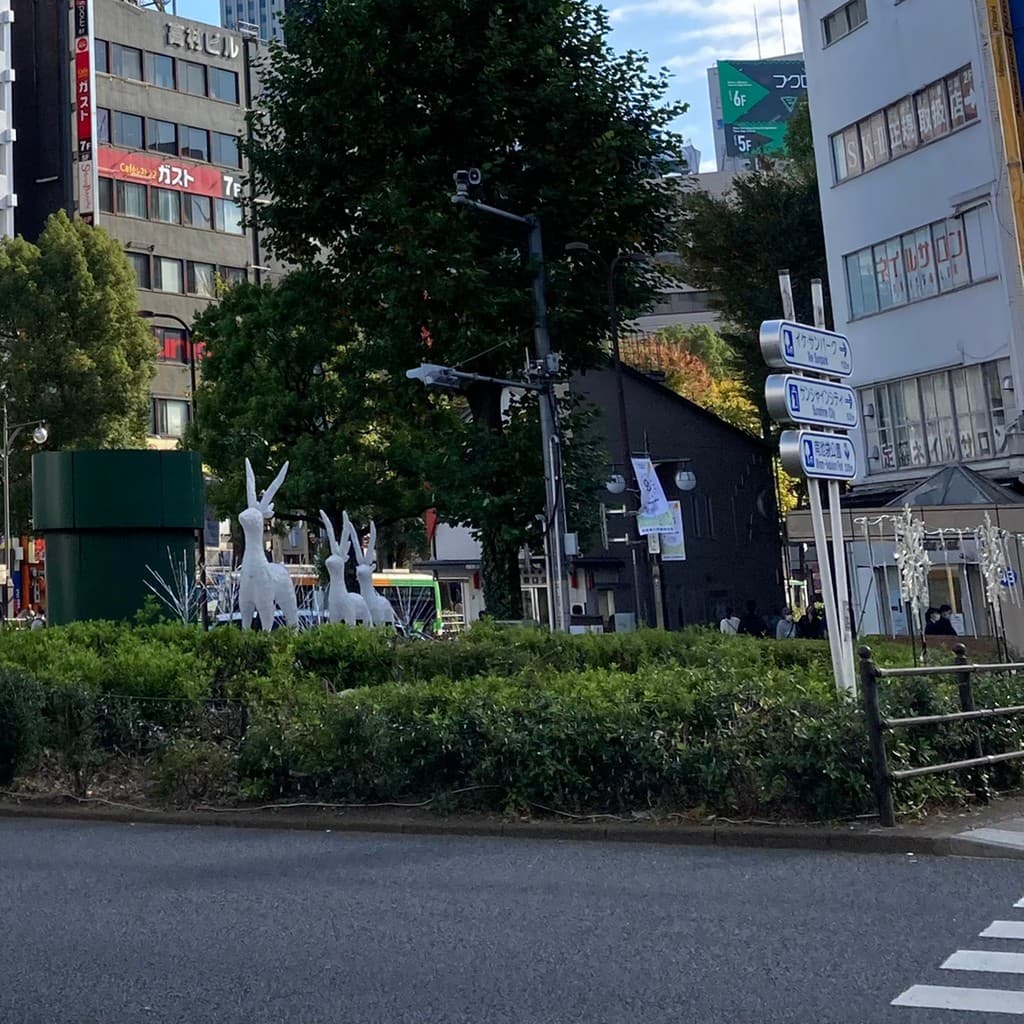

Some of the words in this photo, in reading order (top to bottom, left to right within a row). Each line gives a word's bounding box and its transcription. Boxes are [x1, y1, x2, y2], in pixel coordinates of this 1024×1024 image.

[79, 80, 89, 121] ガスト
[733, 90, 747, 107] 6F
[737, 135, 752, 152] 5F
[158, 164, 194, 188] ガスト
[223, 175, 241, 198] 7F
